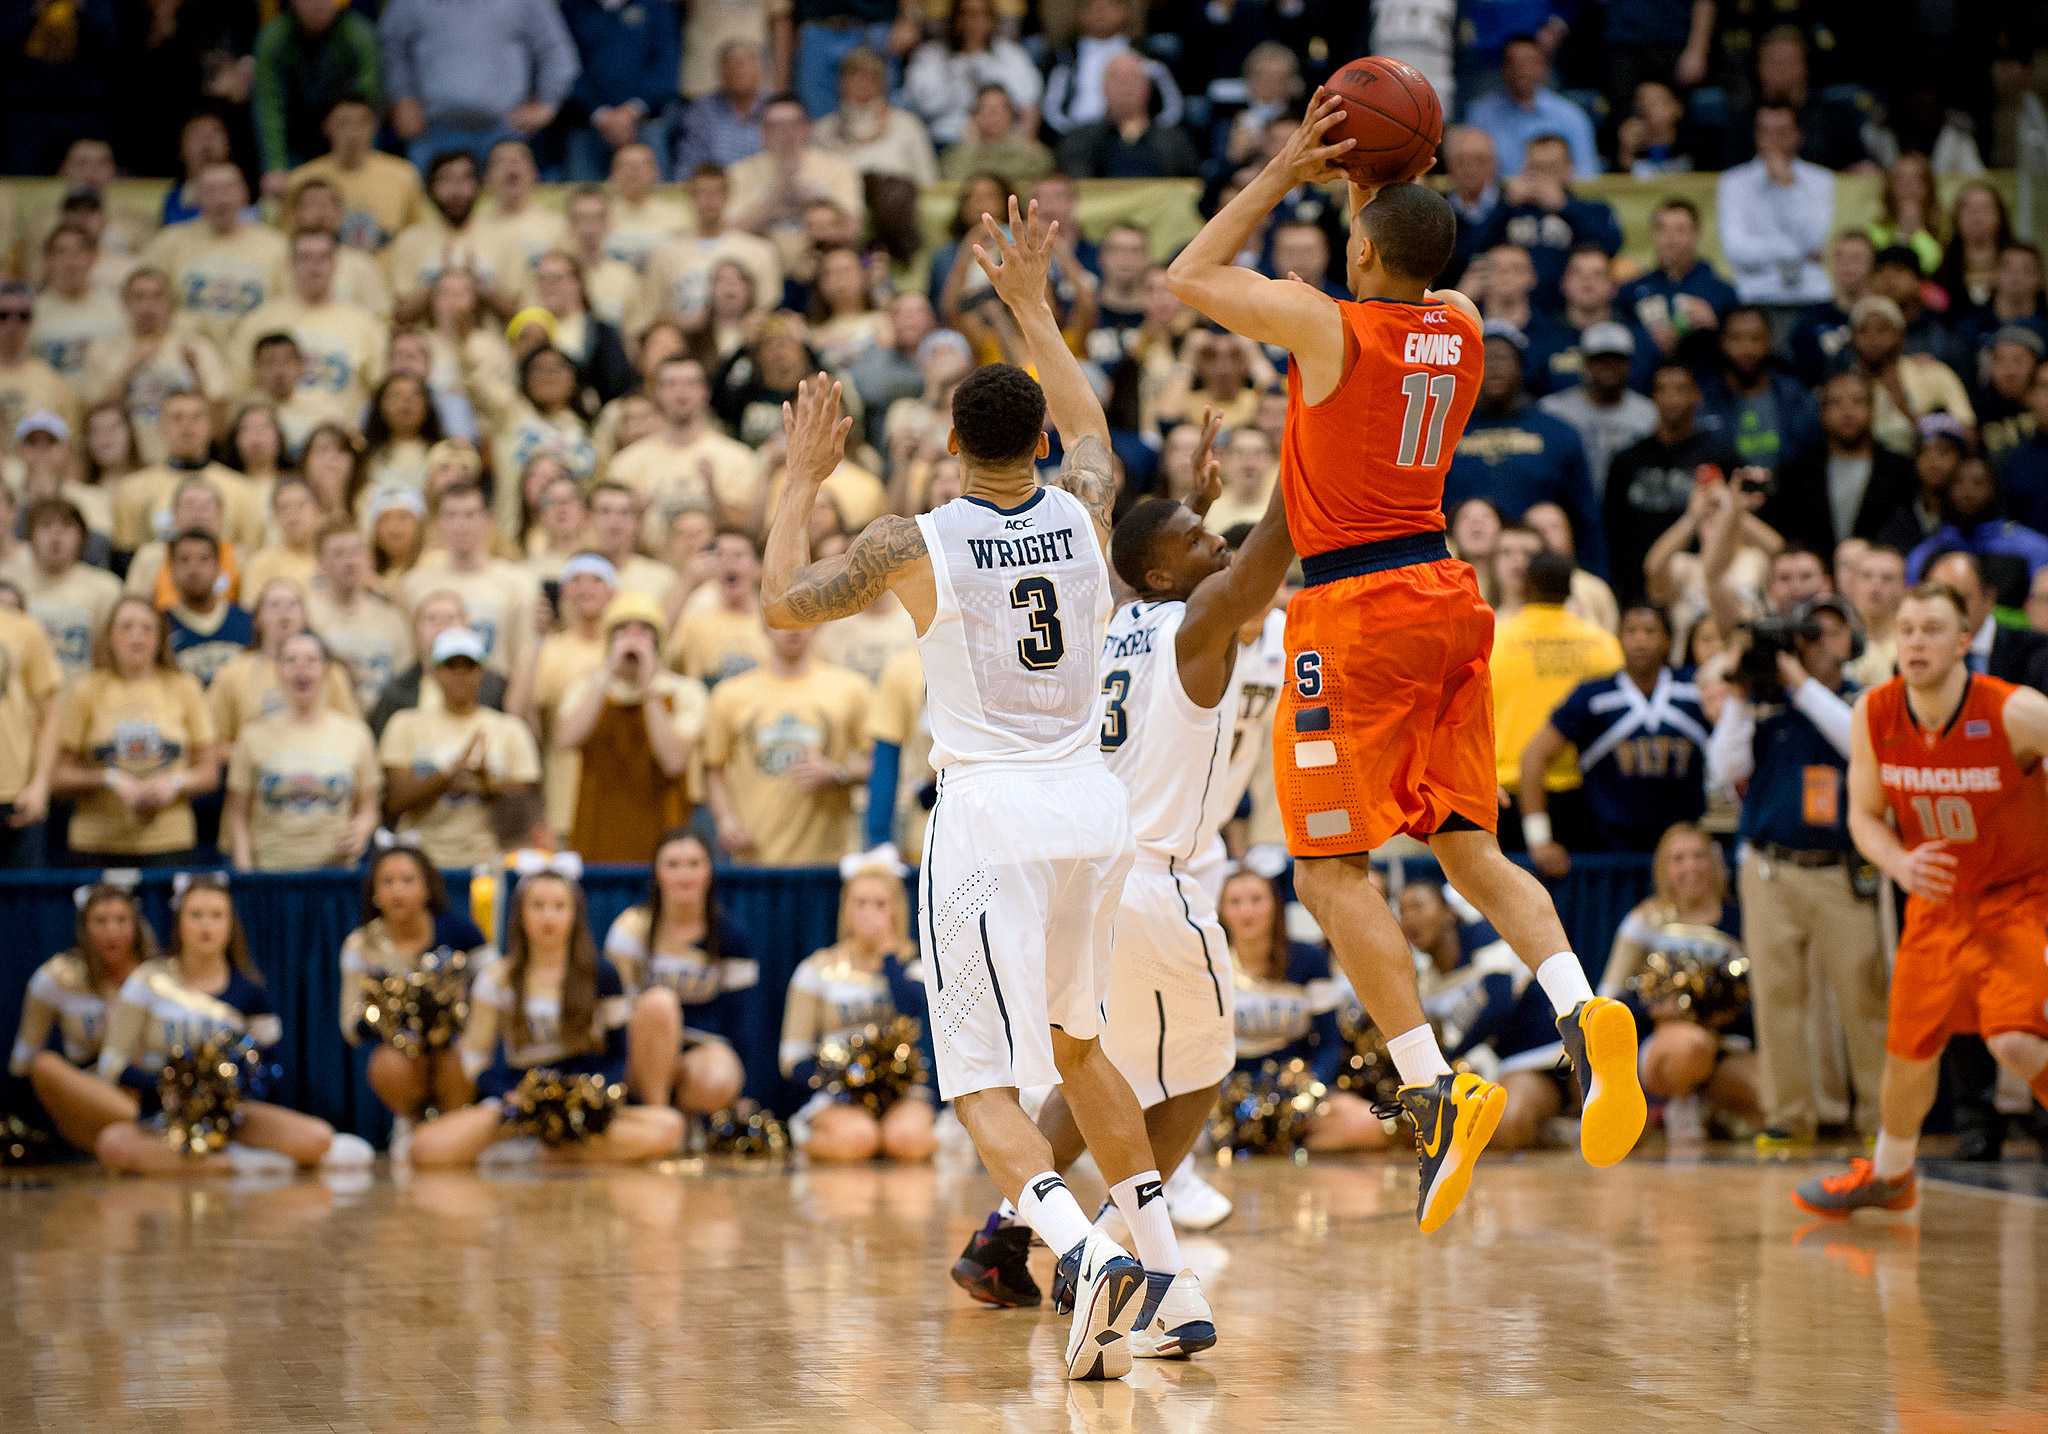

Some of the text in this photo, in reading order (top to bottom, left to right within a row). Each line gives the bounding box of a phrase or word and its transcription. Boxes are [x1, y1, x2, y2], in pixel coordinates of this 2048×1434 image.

[1422, 311, 1448, 323] ACC
[1404, 332, 1463, 366] ENNIS
[1396, 372, 1456, 467] 11
[1004, 518, 1034, 530] ACC
[967, 528, 1073, 569] WRIGHT
[1009, 574, 1066, 671] 3
[1294, 650, 1322, 698] S
[1616, 737, 1691, 778] PITT
[1881, 763, 2001, 793] SYRACUSE
[1910, 796, 1978, 840] 10
